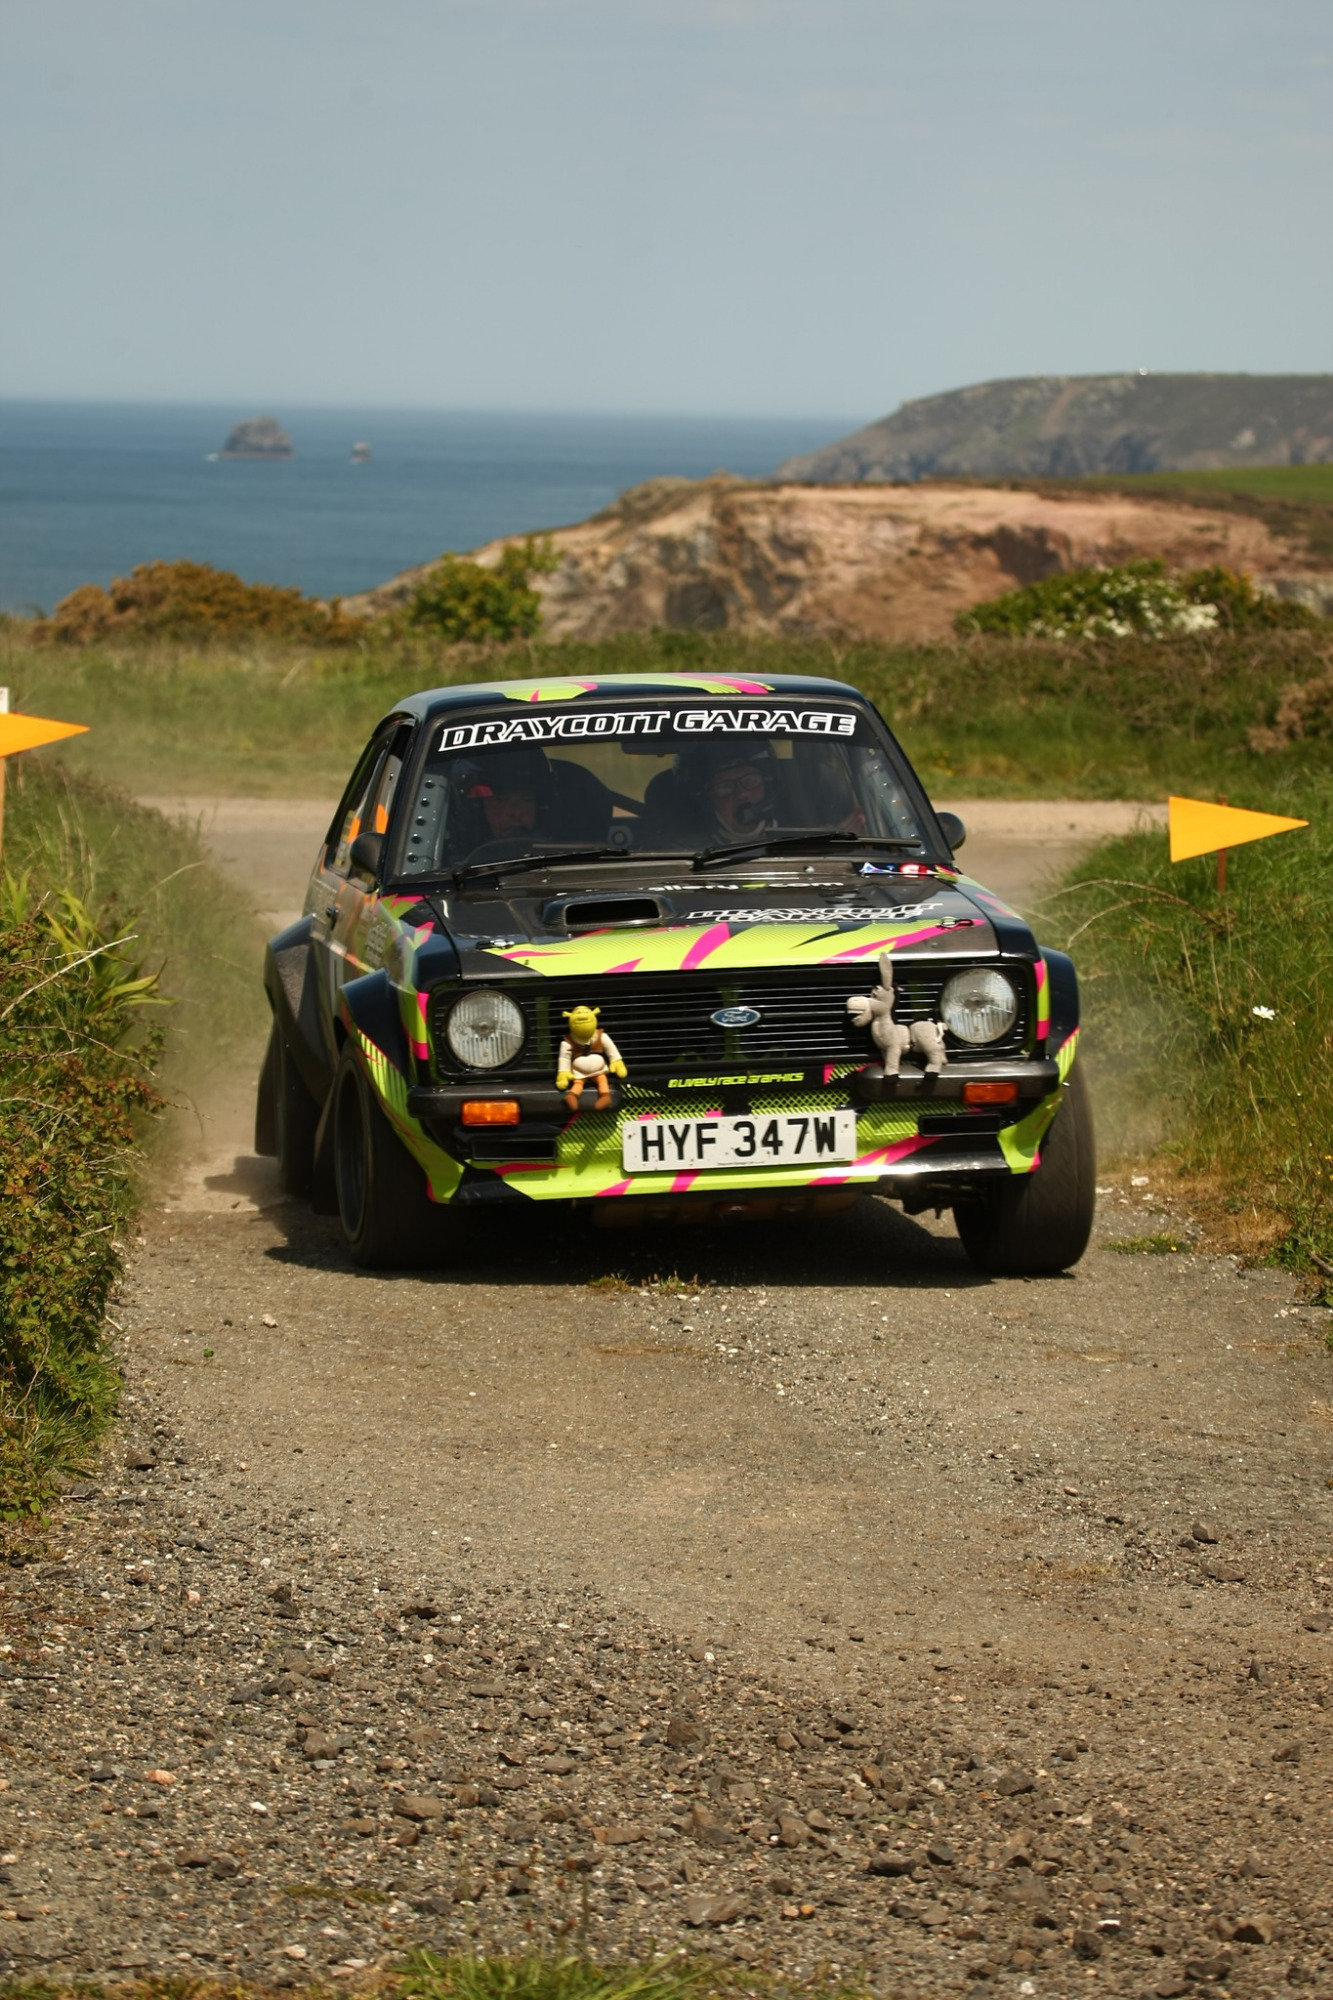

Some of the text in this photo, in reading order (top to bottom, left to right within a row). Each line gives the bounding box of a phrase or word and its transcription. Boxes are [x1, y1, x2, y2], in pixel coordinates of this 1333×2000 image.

[438, 710, 857, 752] DRAYCOTT GARAGE
[640, 1116, 836, 1162] HYF 347W
